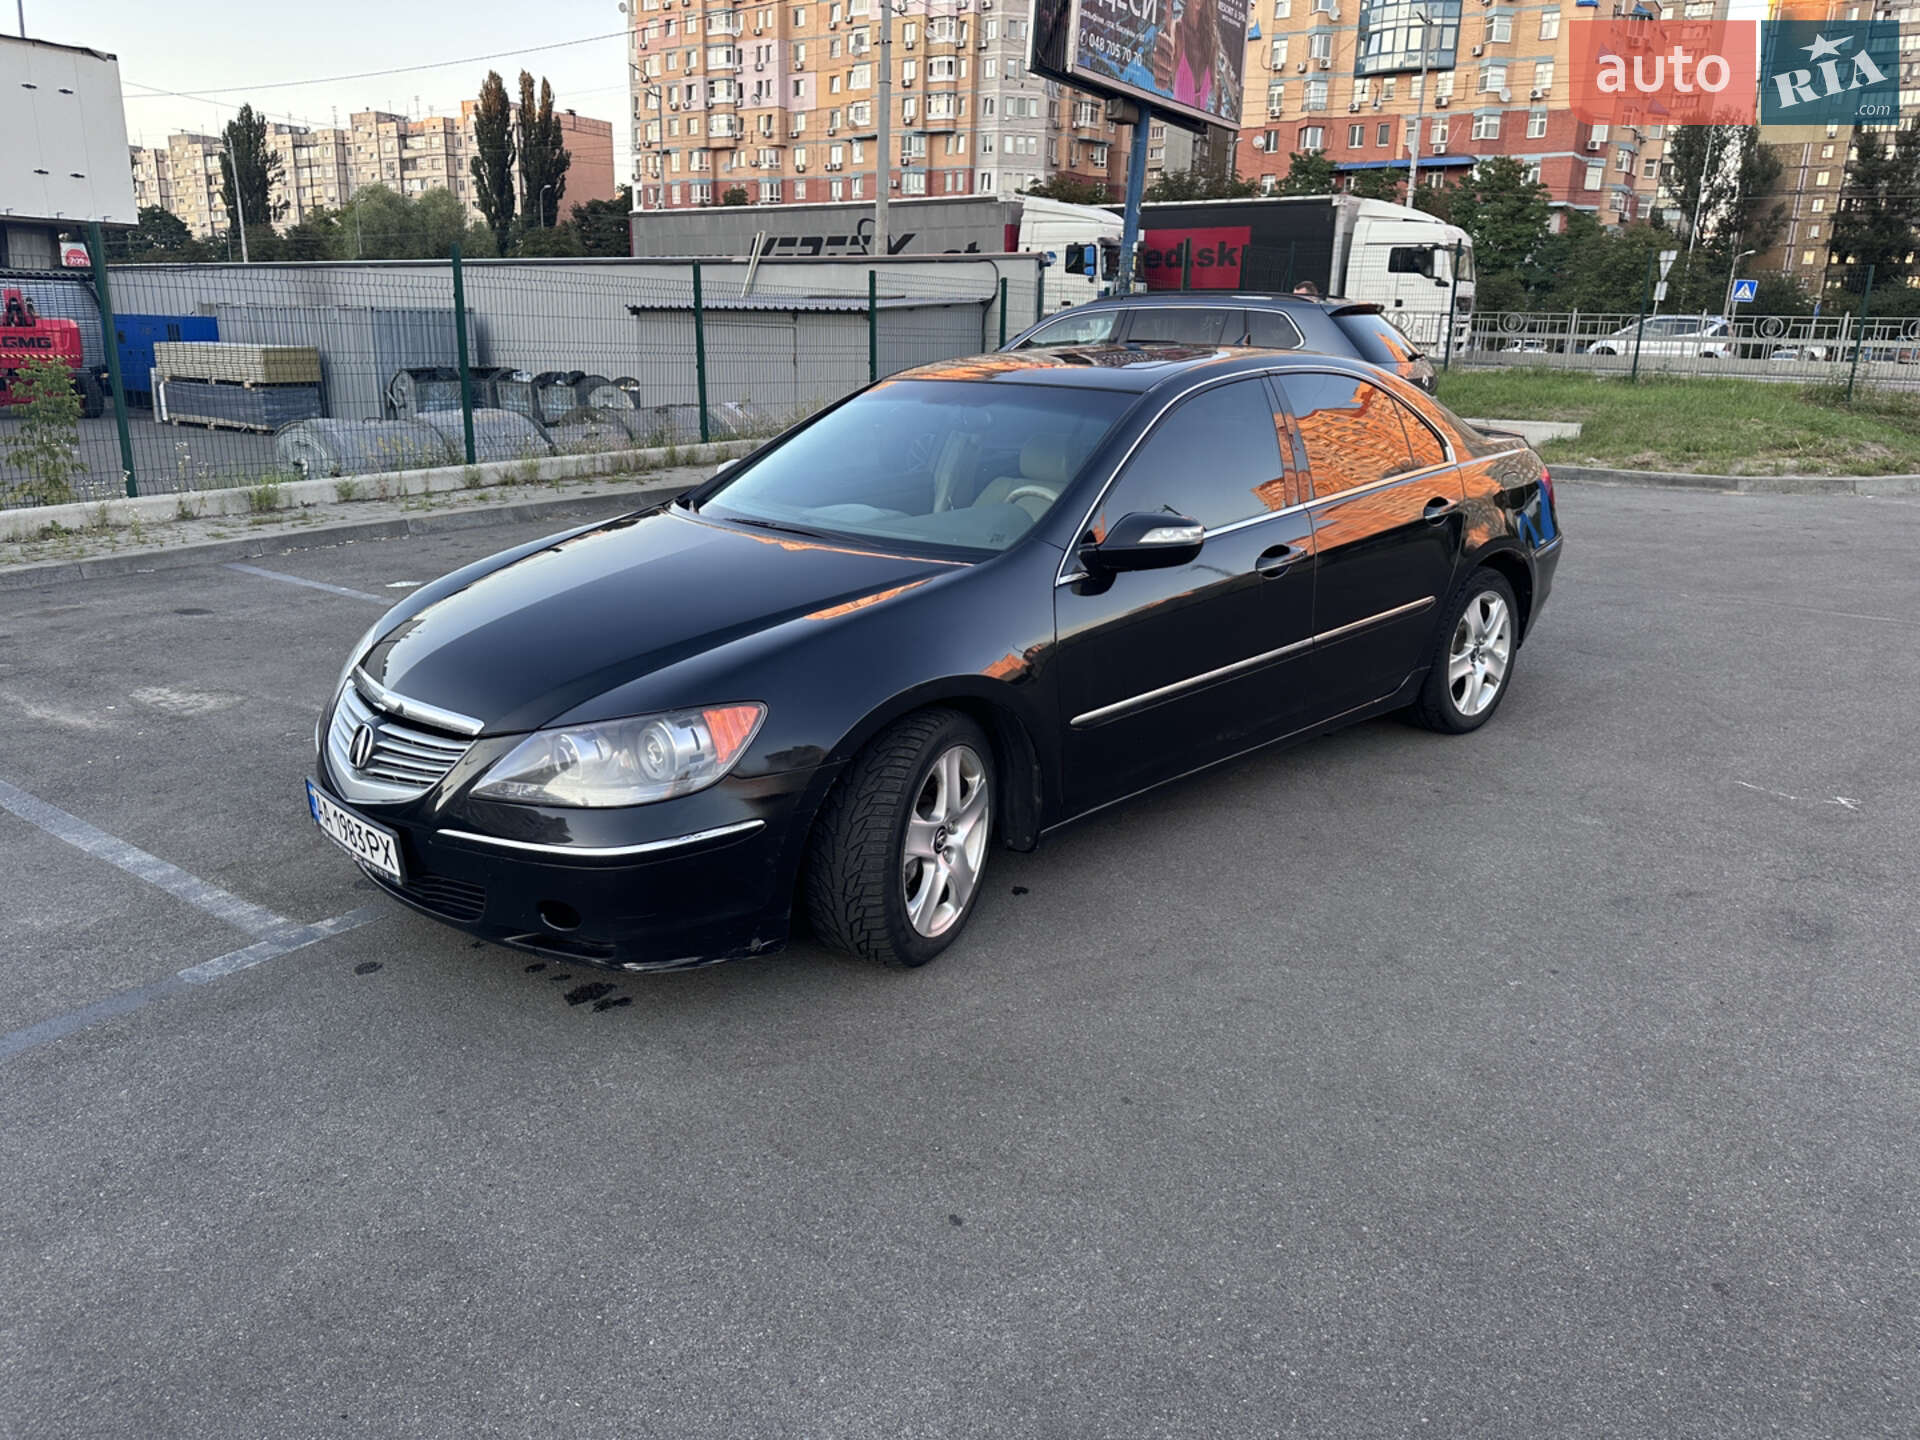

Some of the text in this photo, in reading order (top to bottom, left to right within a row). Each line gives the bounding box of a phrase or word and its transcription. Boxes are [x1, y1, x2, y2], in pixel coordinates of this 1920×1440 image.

[1088, 33, 1143, 67] 048 705 70 70
[0, 336, 52, 348] GMG
